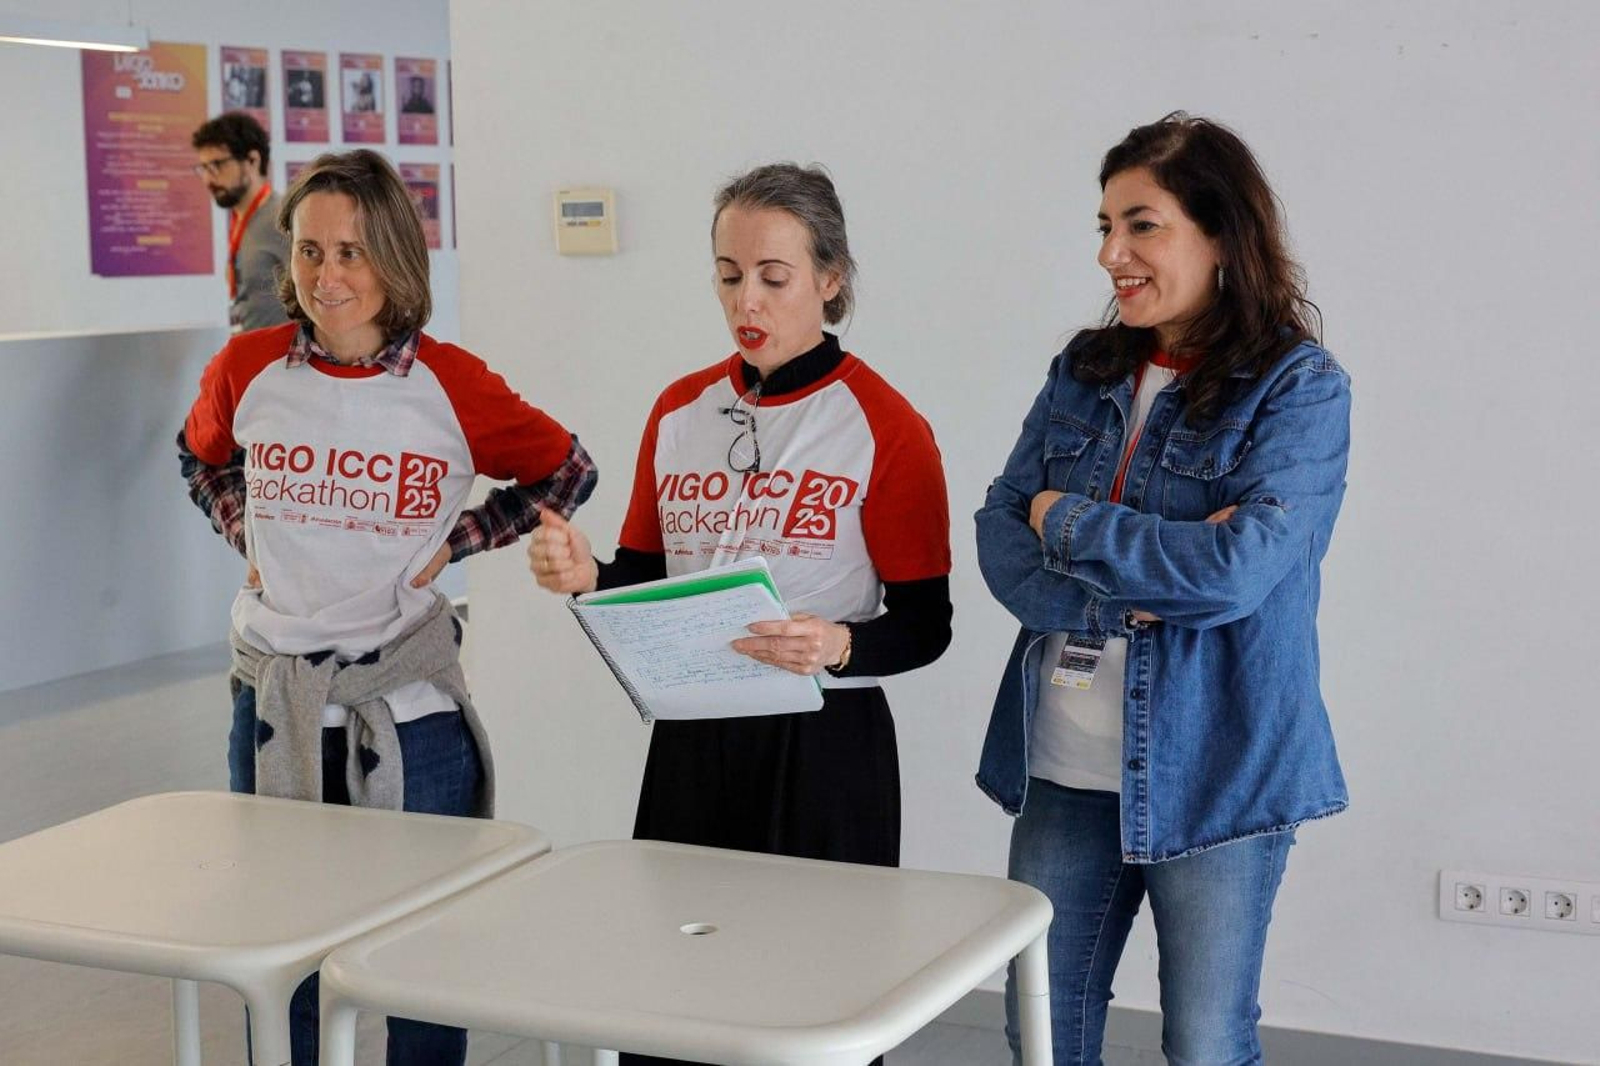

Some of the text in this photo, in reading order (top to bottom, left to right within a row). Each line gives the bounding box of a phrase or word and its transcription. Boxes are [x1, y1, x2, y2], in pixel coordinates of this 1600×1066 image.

[327, 448, 394, 483] ICC
[405, 458, 443, 488] 20
[401, 488, 437, 516] 25
[800, 478, 848, 510] 20
[790, 508, 831, 536] 25
